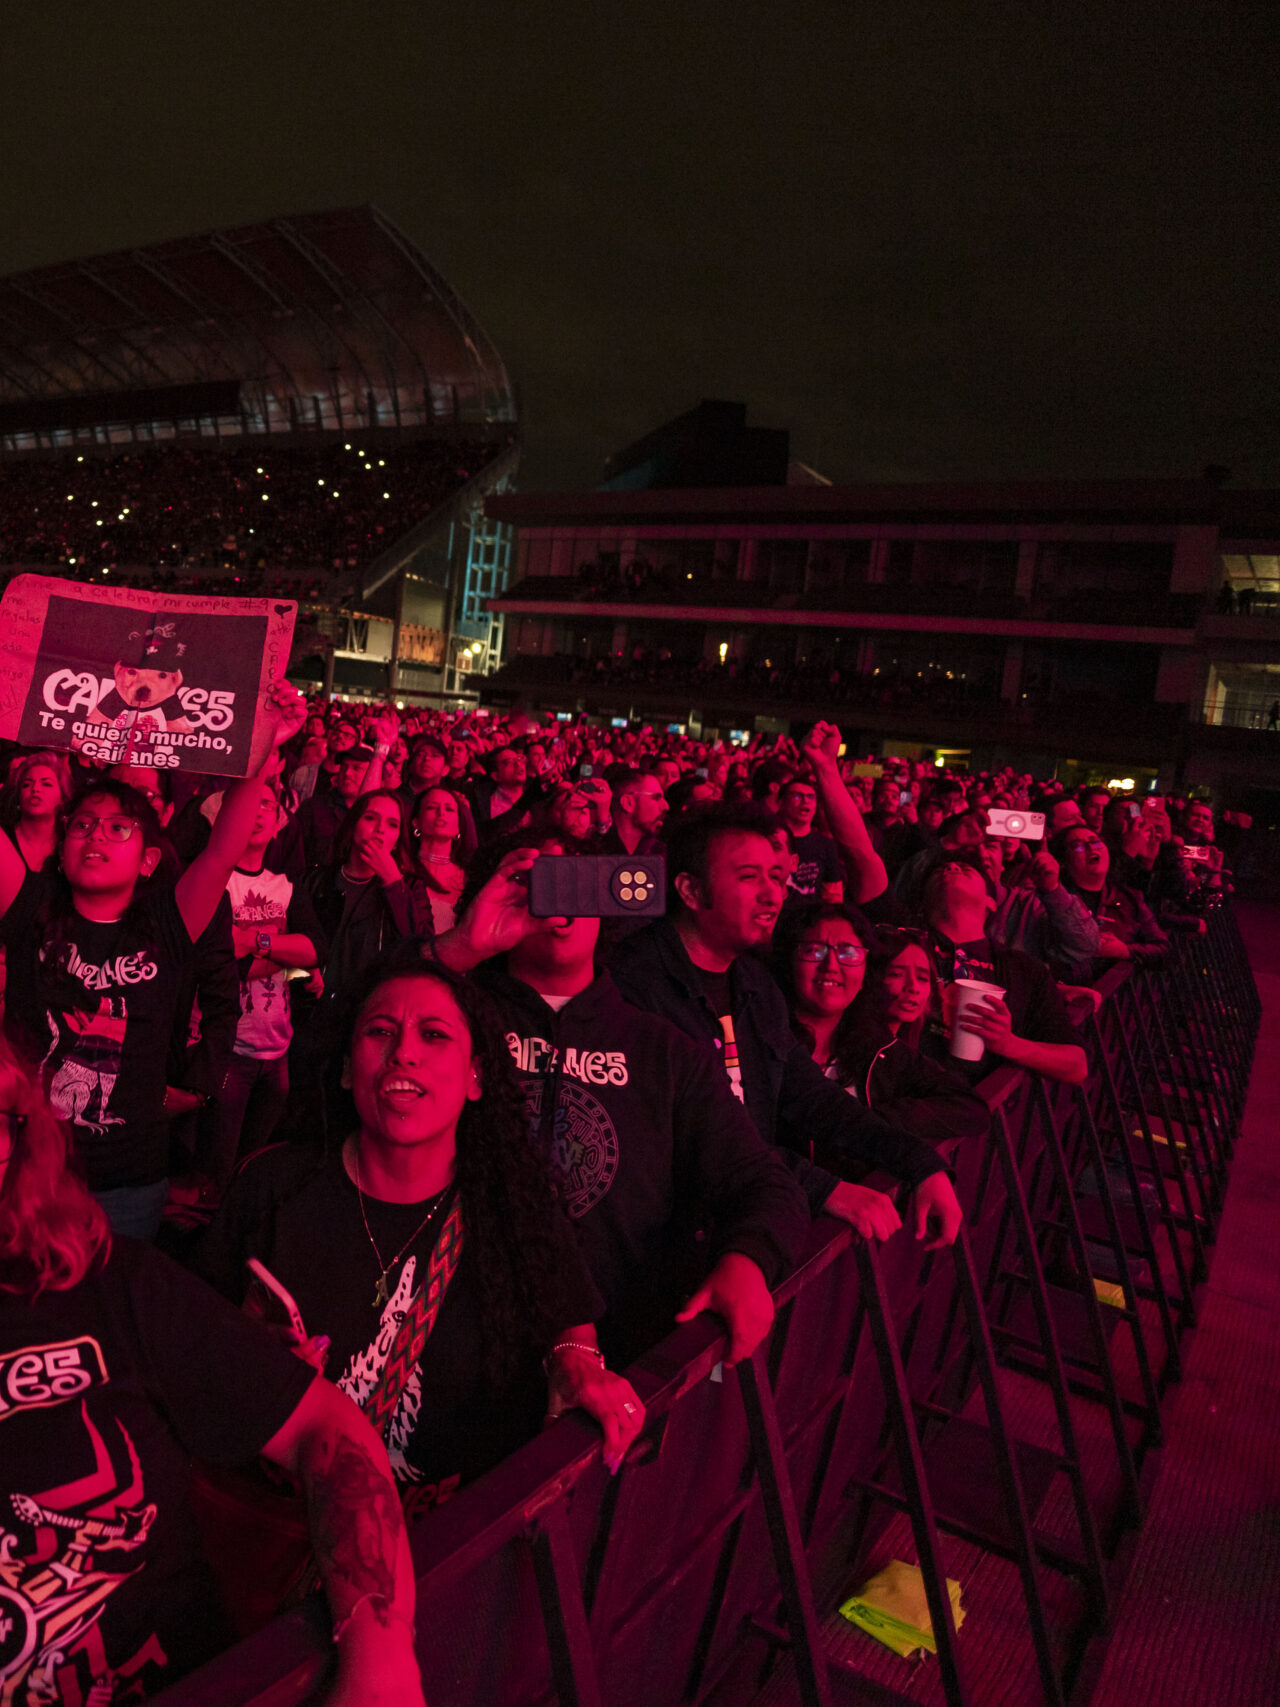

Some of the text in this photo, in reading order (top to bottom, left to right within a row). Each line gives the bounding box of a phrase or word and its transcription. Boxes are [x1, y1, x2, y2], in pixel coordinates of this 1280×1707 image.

[39, 711, 232, 754] Te quiero mucho,
